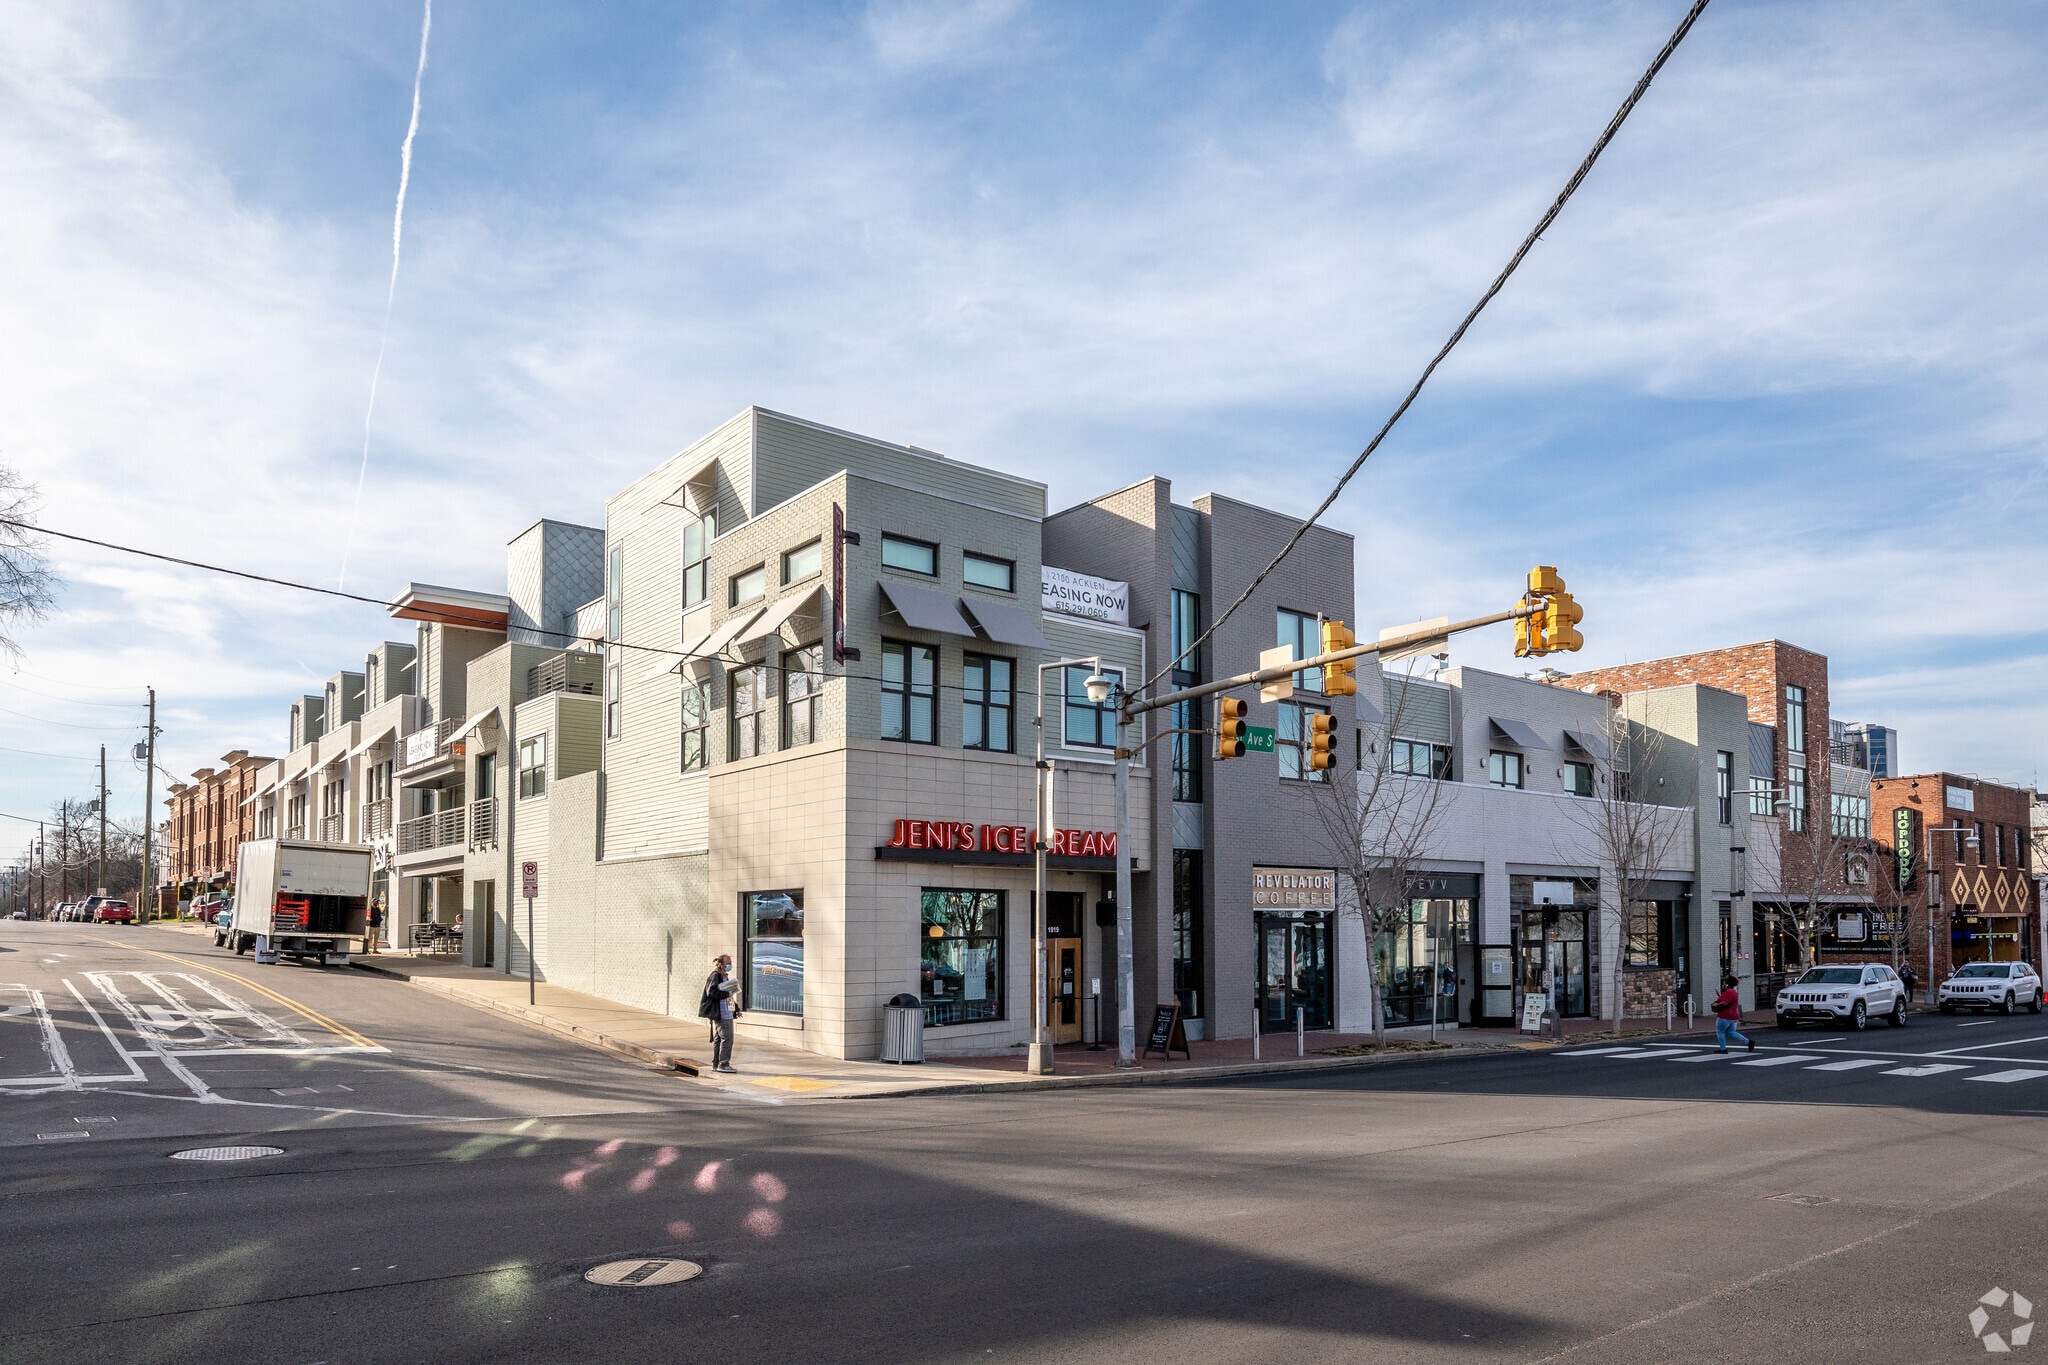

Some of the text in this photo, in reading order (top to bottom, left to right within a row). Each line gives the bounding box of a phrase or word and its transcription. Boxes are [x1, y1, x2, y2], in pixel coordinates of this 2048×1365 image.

[1051, 571, 1106, 592] 2100 ACKLEN
[1041, 582, 1126, 612] EASING NOW
[1055, 600, 1109, 619] 615.291.0606
[1247, 732, 1264, 746] Ave
[1266, 734, 1273, 747] S
[887, 819, 975, 851] JENI'S
[981, 824, 1027, 854] ICE
[1255, 874, 1330, 889] REVELATOR
[1256, 891, 1330, 905] COFFEE
